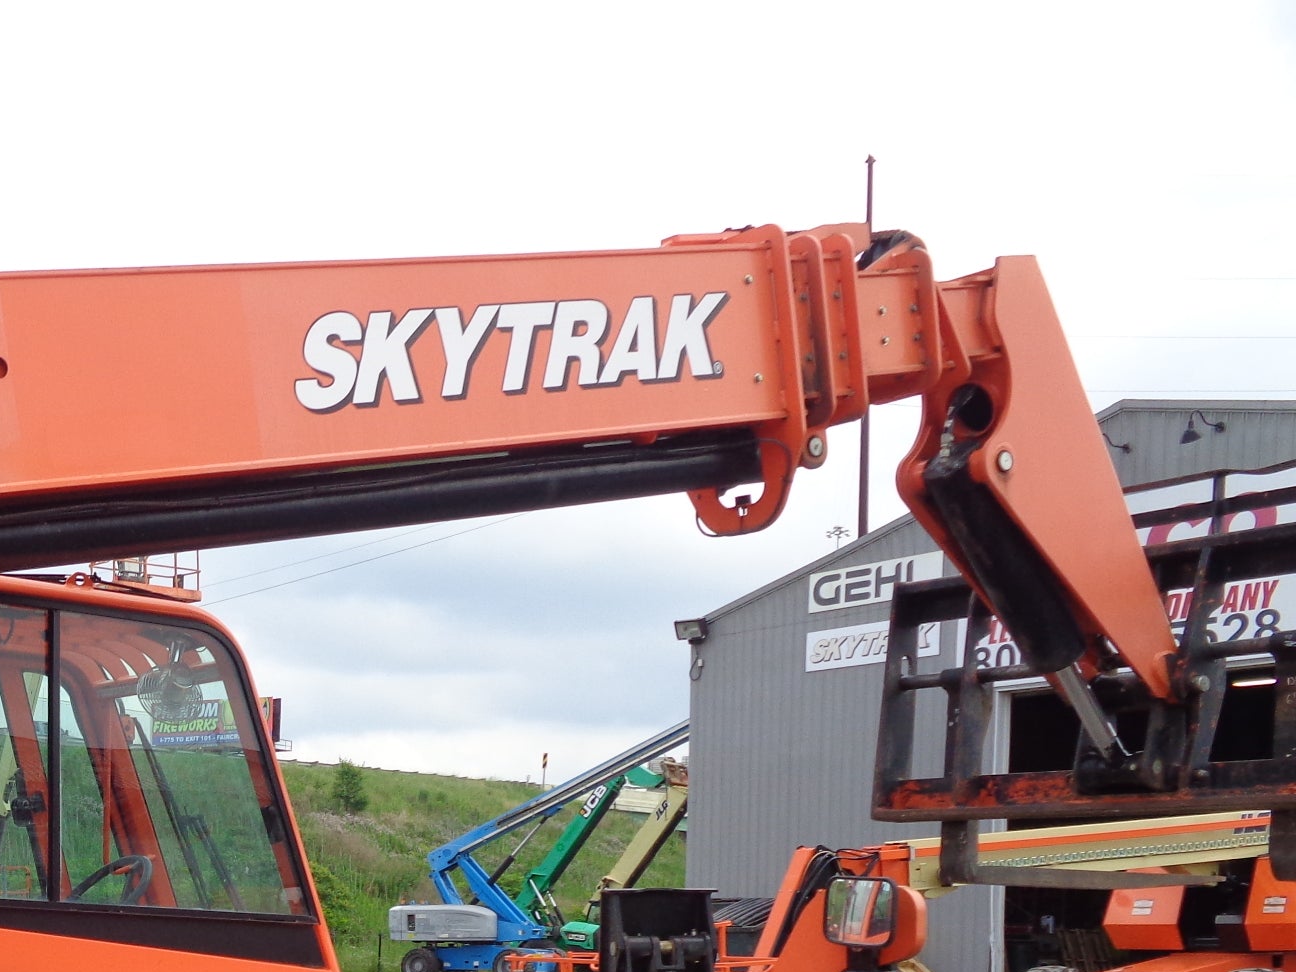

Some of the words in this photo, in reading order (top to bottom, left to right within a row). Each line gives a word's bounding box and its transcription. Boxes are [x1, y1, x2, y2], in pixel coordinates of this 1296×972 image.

[294, 291, 728, 414] SKYTRAK
[810, 624, 936, 664] SKYTRK
[581, 785, 607, 818] JCB
[656, 799, 669, 821] JLG
